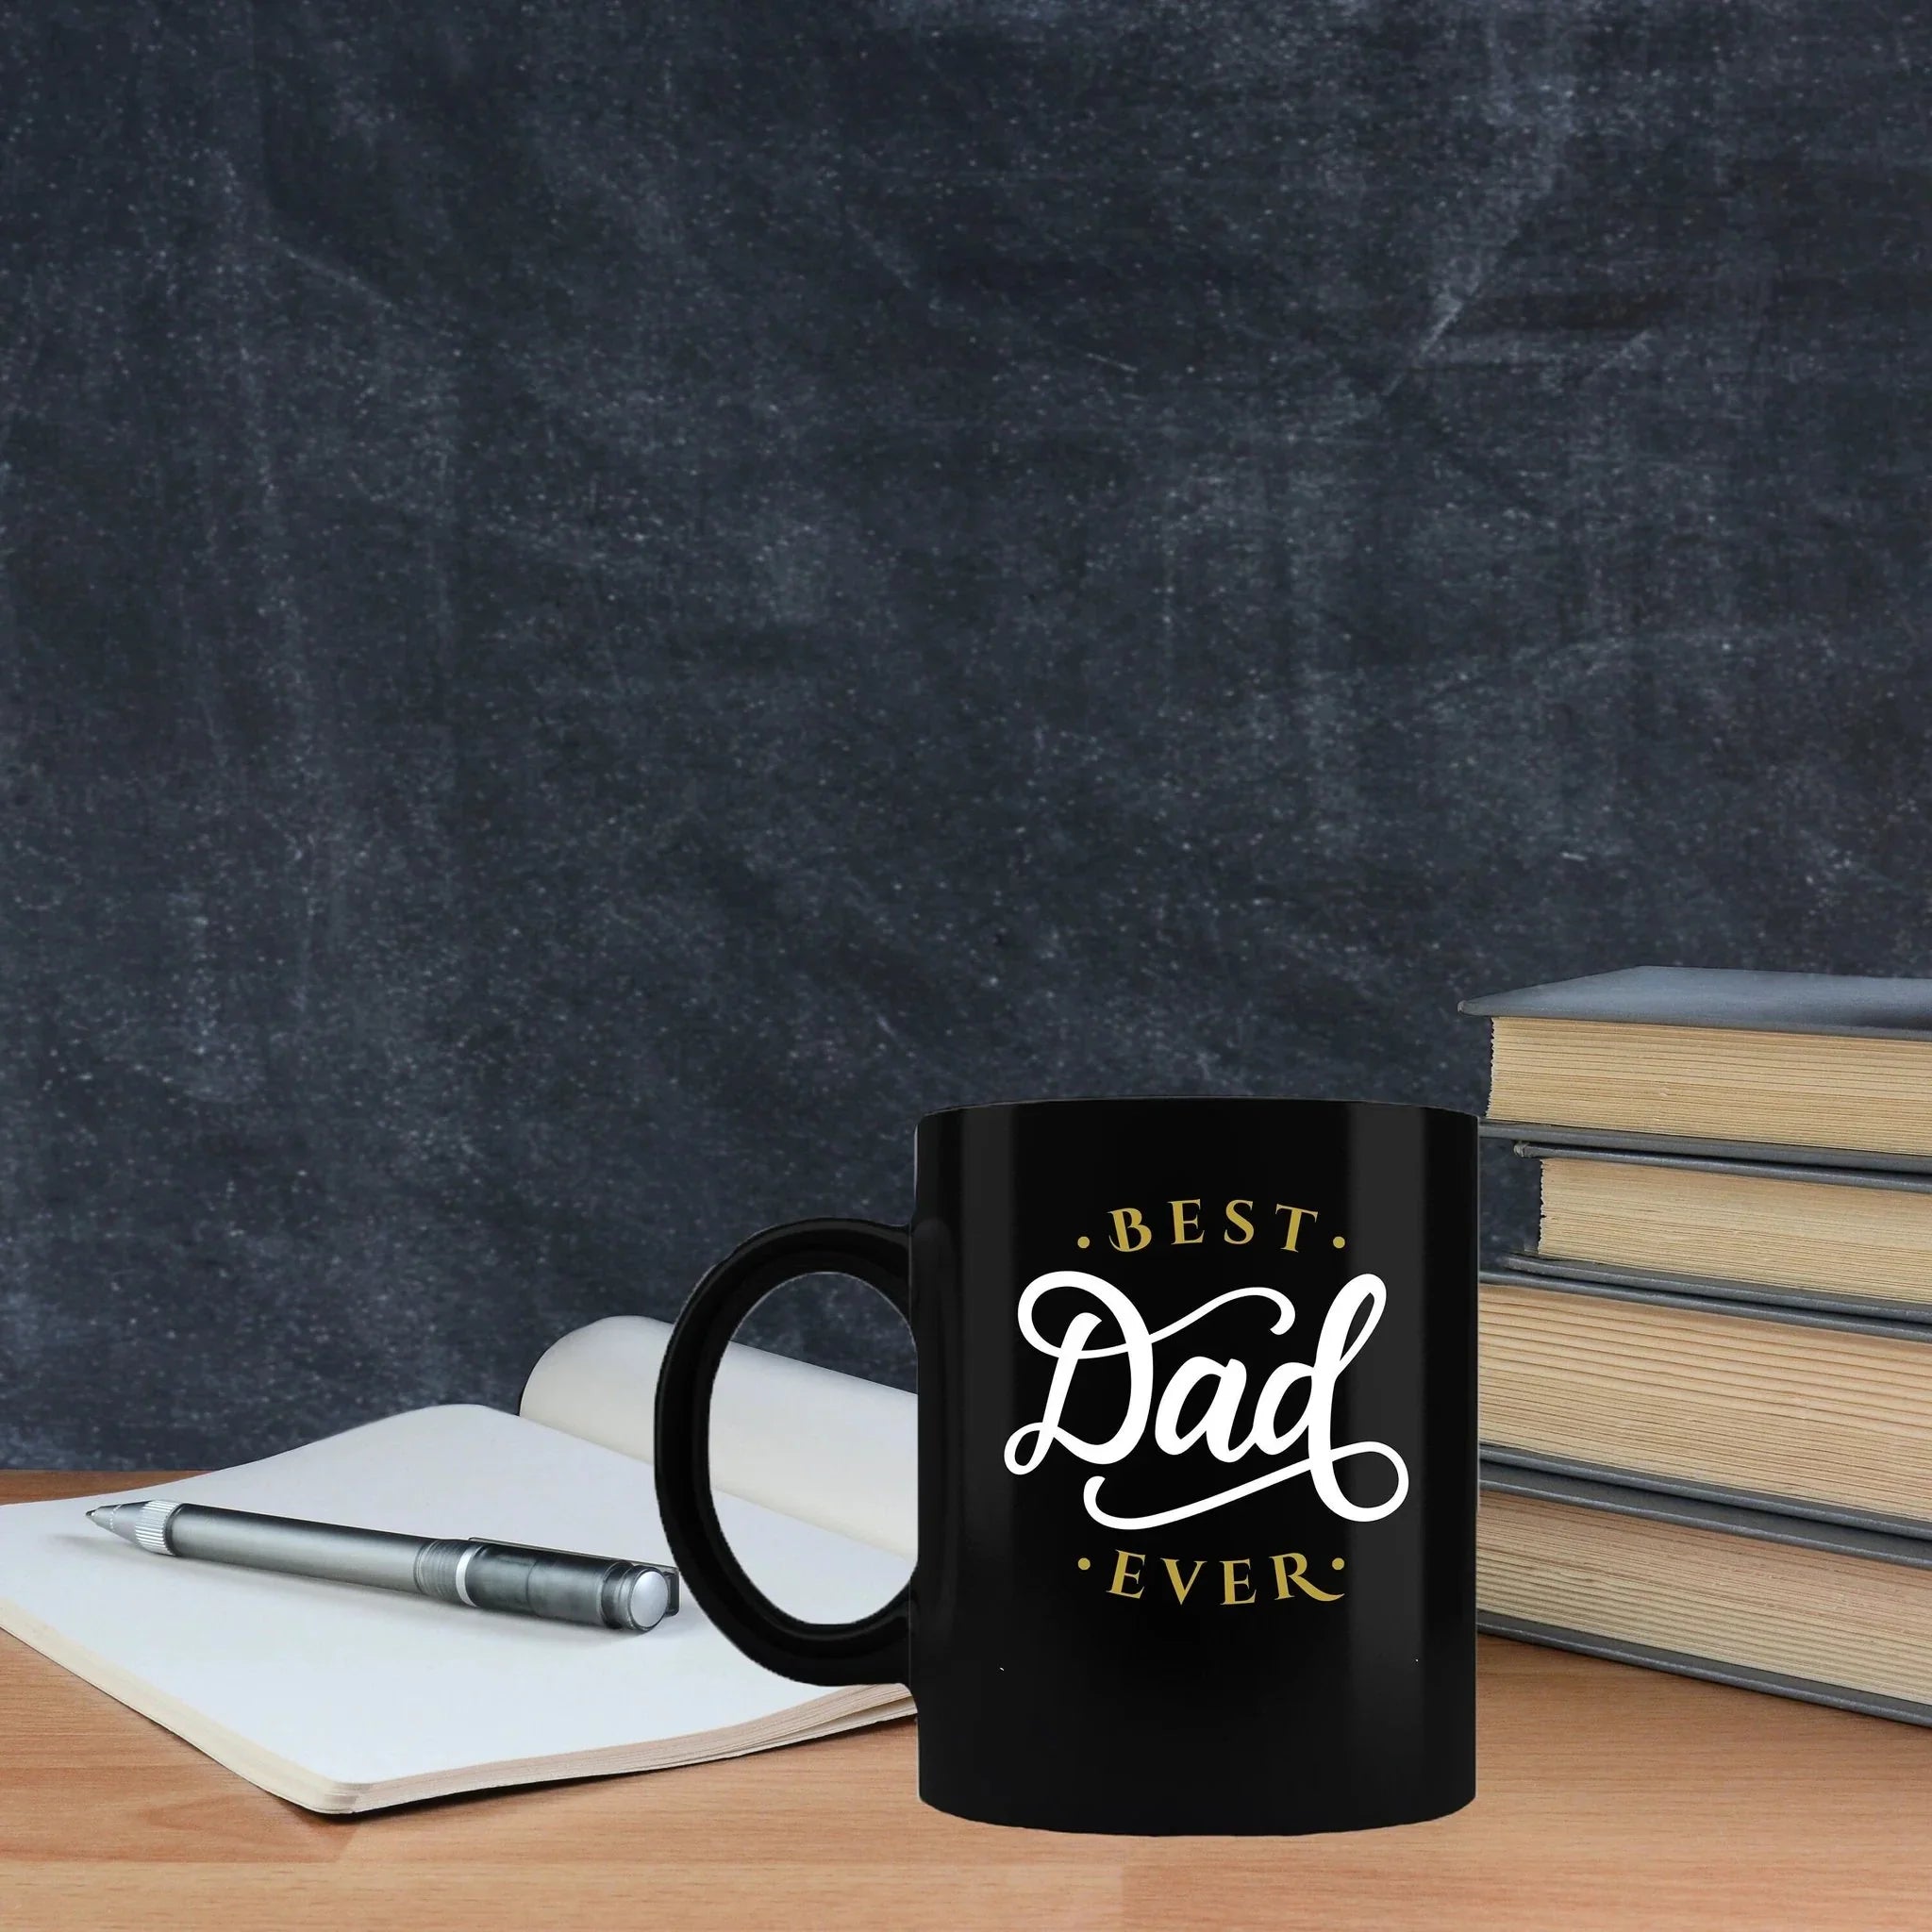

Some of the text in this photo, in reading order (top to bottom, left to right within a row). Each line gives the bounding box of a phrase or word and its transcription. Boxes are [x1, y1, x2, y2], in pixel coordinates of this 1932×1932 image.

[1108, 1198, 1319, 1253] BEST
[1003, 1270, 1409, 1530] Dad
[1106, 1549, 1345, 1606] EVER
